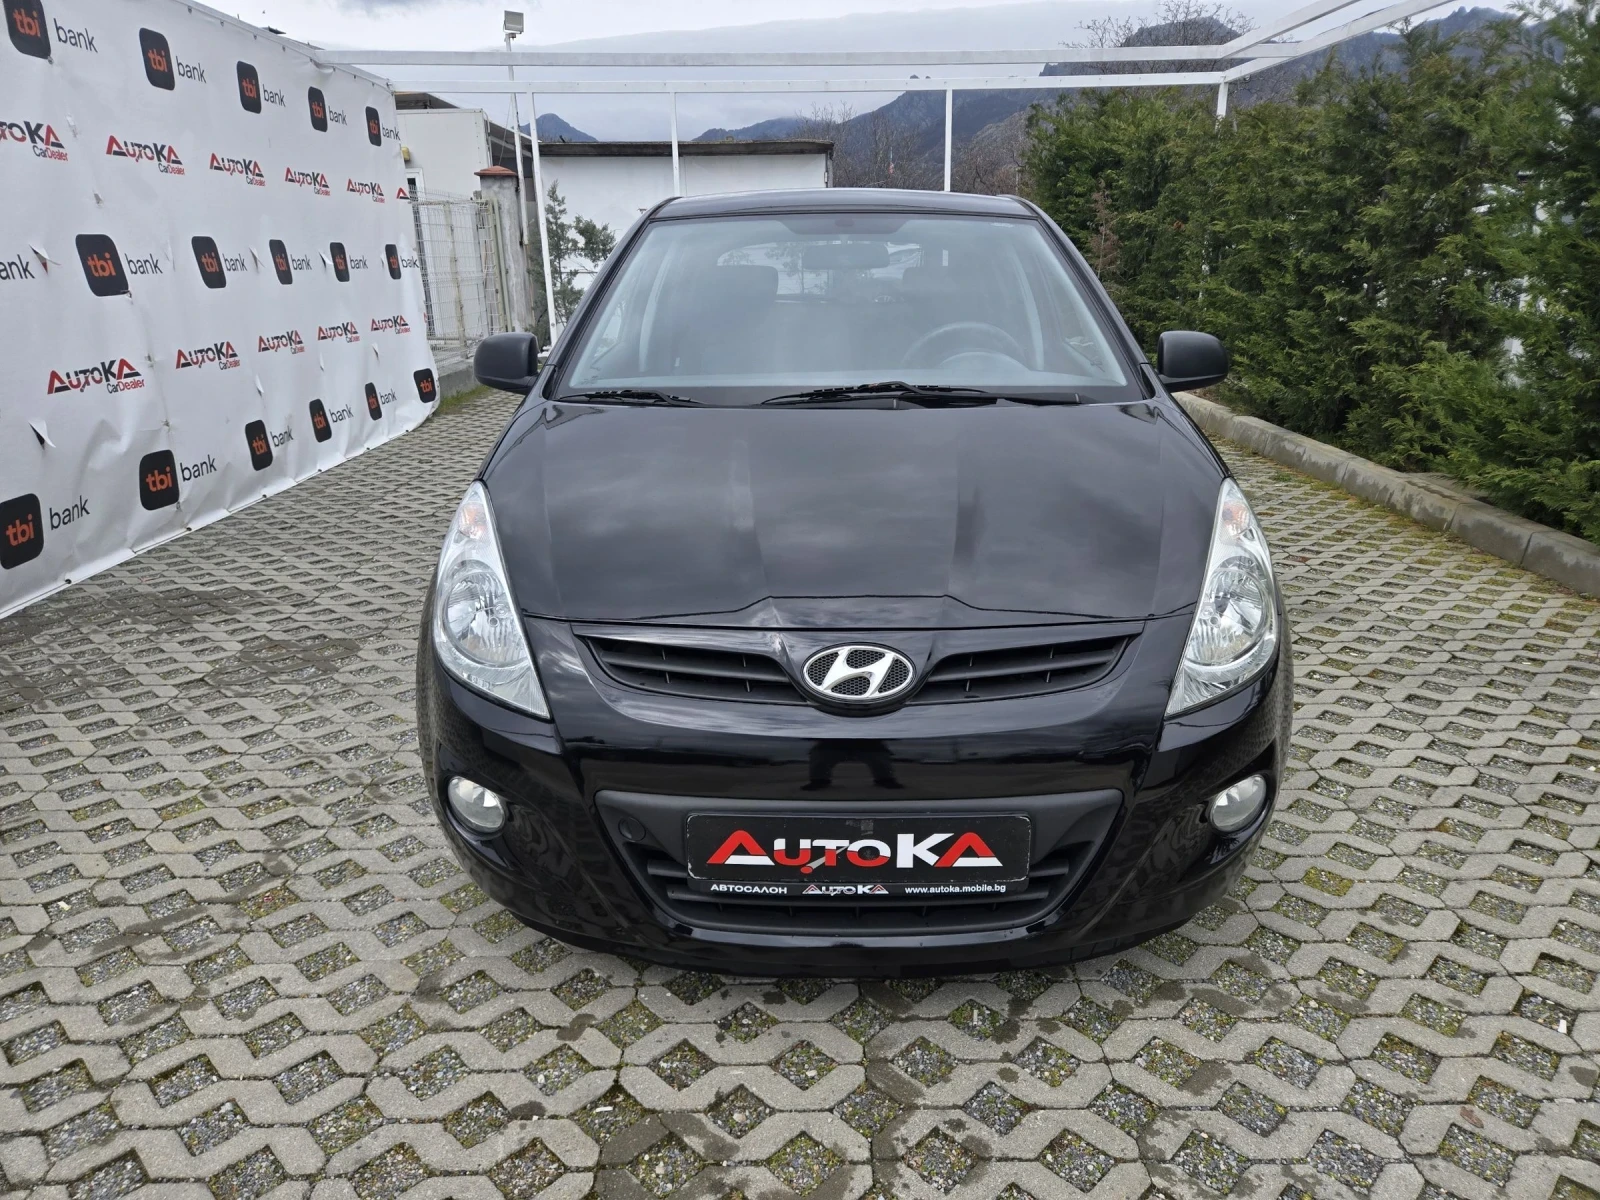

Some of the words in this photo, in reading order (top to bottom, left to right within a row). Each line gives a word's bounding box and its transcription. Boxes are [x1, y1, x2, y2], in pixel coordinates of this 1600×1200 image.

[13, 8, 41, 37] tbi
[53, 18, 98, 53] bank
[148, 48, 168, 72] tbi
[175, 56, 207, 83] bank
[241, 77, 257, 98] tbi
[263, 84, 286, 107] bank
[311, 101, 325, 119] tbi
[329, 106, 348, 126] bank
[381, 123, 401, 141] bank
[0, 254, 35, 280] ank
[87, 252, 116, 277] tbi
[124, 253, 163, 275] bank
[202, 252, 218, 273] tbi
[223, 253, 248, 272] bank
[276, 254, 288, 272] tbi
[291, 254, 312, 271] bank
[350, 254, 368, 270] bank
[176, 341, 239, 369] AUTOKA
[47, 358, 142, 395] AUTOKA
[106, 378, 145, 394] CarDealer
[380, 389, 397, 405] bank
[329, 404, 354, 423] bank
[252, 433, 267, 455] tbi
[270, 427, 294, 447] bank
[145, 466, 172, 492] tbi
[180, 454, 217, 482] bank
[6, 514, 34, 546] tbi
[49, 495, 91, 531] bank
[706, 829, 1003, 874] AUTOKA
[710, 883, 788, 895] АВТОСАЛОН
[802, 884, 889, 896] AUTOKA
[904, 883, 1006, 894] www.autoka.mobile.bg
